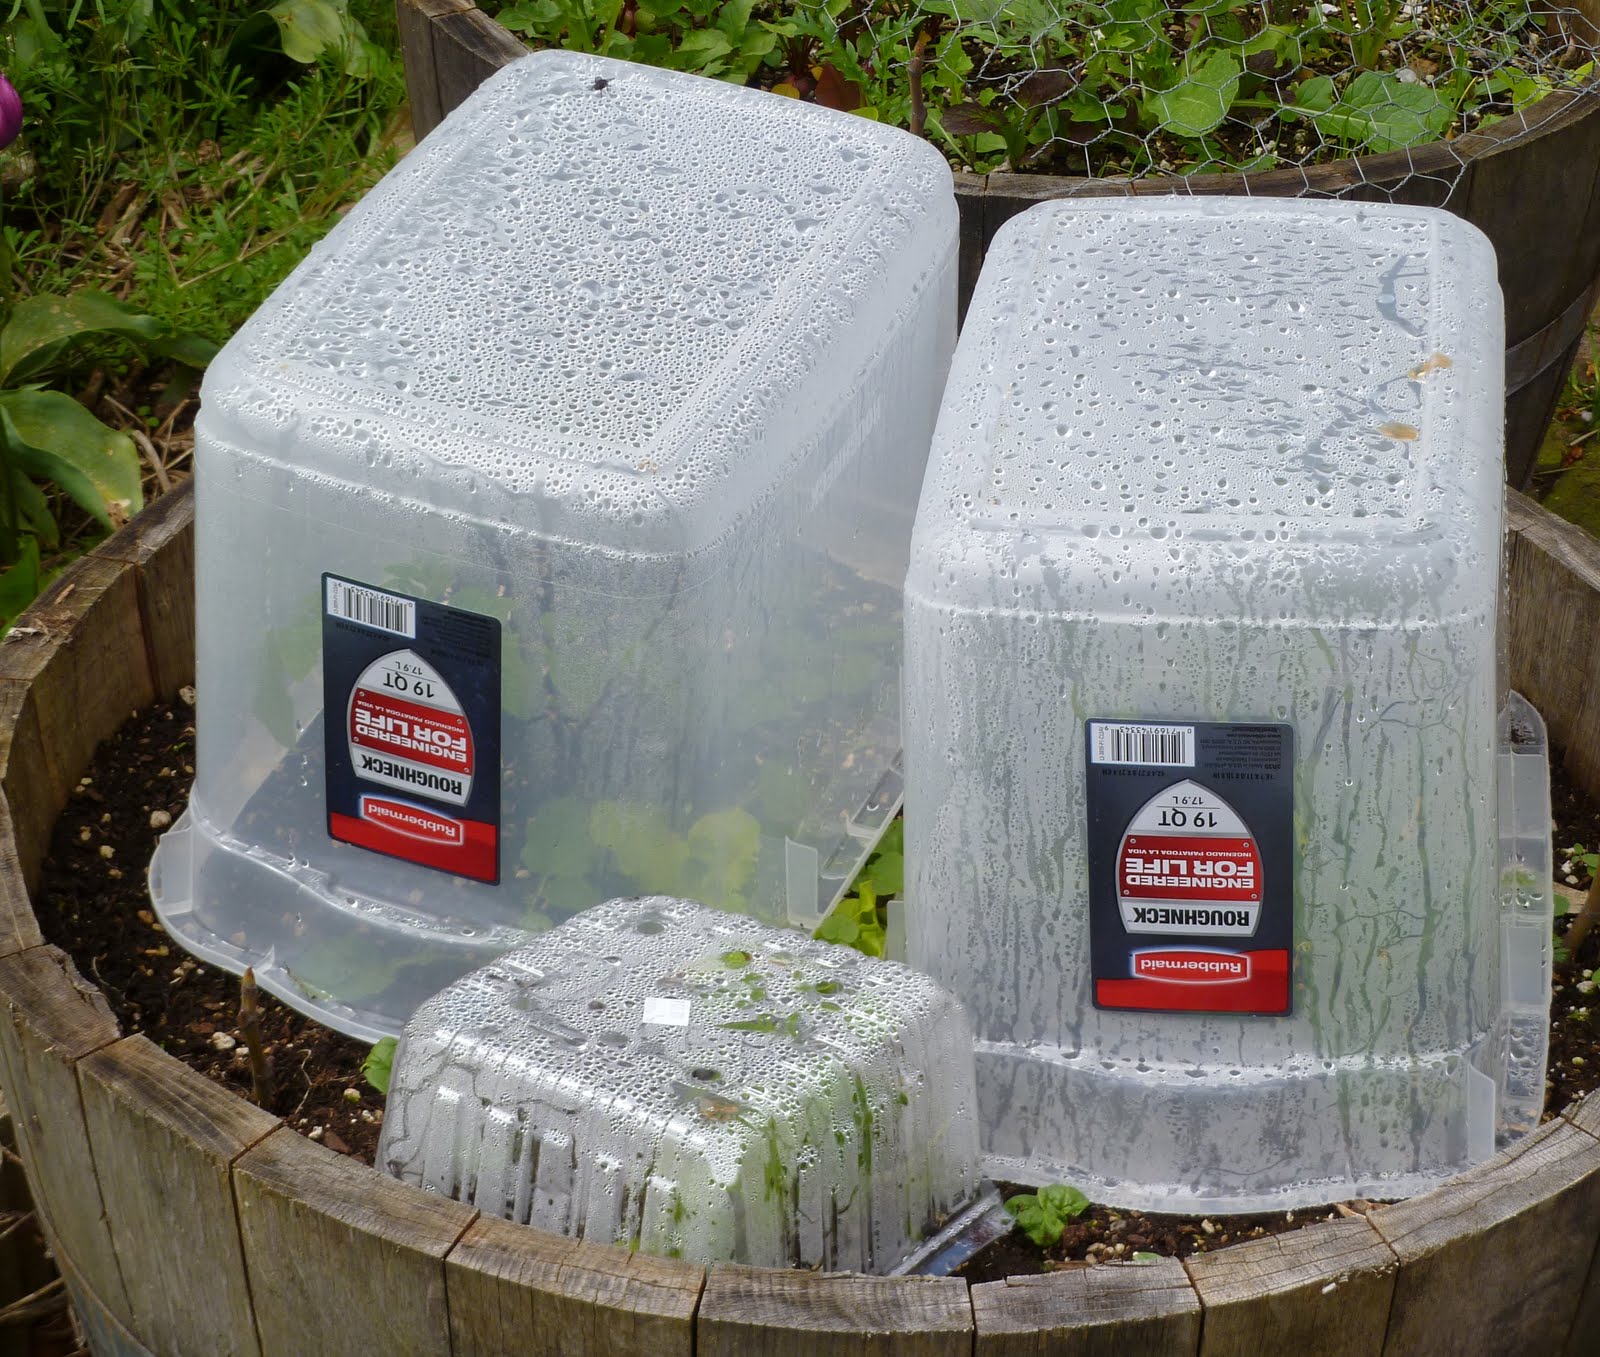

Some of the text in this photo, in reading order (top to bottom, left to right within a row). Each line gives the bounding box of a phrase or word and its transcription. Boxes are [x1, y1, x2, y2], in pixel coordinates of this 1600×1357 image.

[395, 661, 423, 675] 17.9 L
[383, 672, 435, 698] 19 QT
[357, 700, 373, 709] VIDA
[385, 708, 423, 723] PARATODA
[355, 708, 467, 752] FOR LIFE
[424, 719, 465, 733] INGENIADO
[1119, 725, 1147, 734] 43343
[1149, 726, 1176, 735] 71691
[356, 724, 467, 763] ENGINEERED
[361, 754, 462, 796] ROUGHNECK
[1172, 796, 1204, 805] 17.9 L
[368, 804, 456, 837] Rubbermaid
[1158, 807, 1218, 828] 19 QT
[1125, 857, 1254, 877] FOR LIFE
[1126, 874, 1255, 889] ENGINEERED
[1133, 907, 1250, 927] ROUGHNECK
[1141, 959, 1241, 973] Rubbermaid
